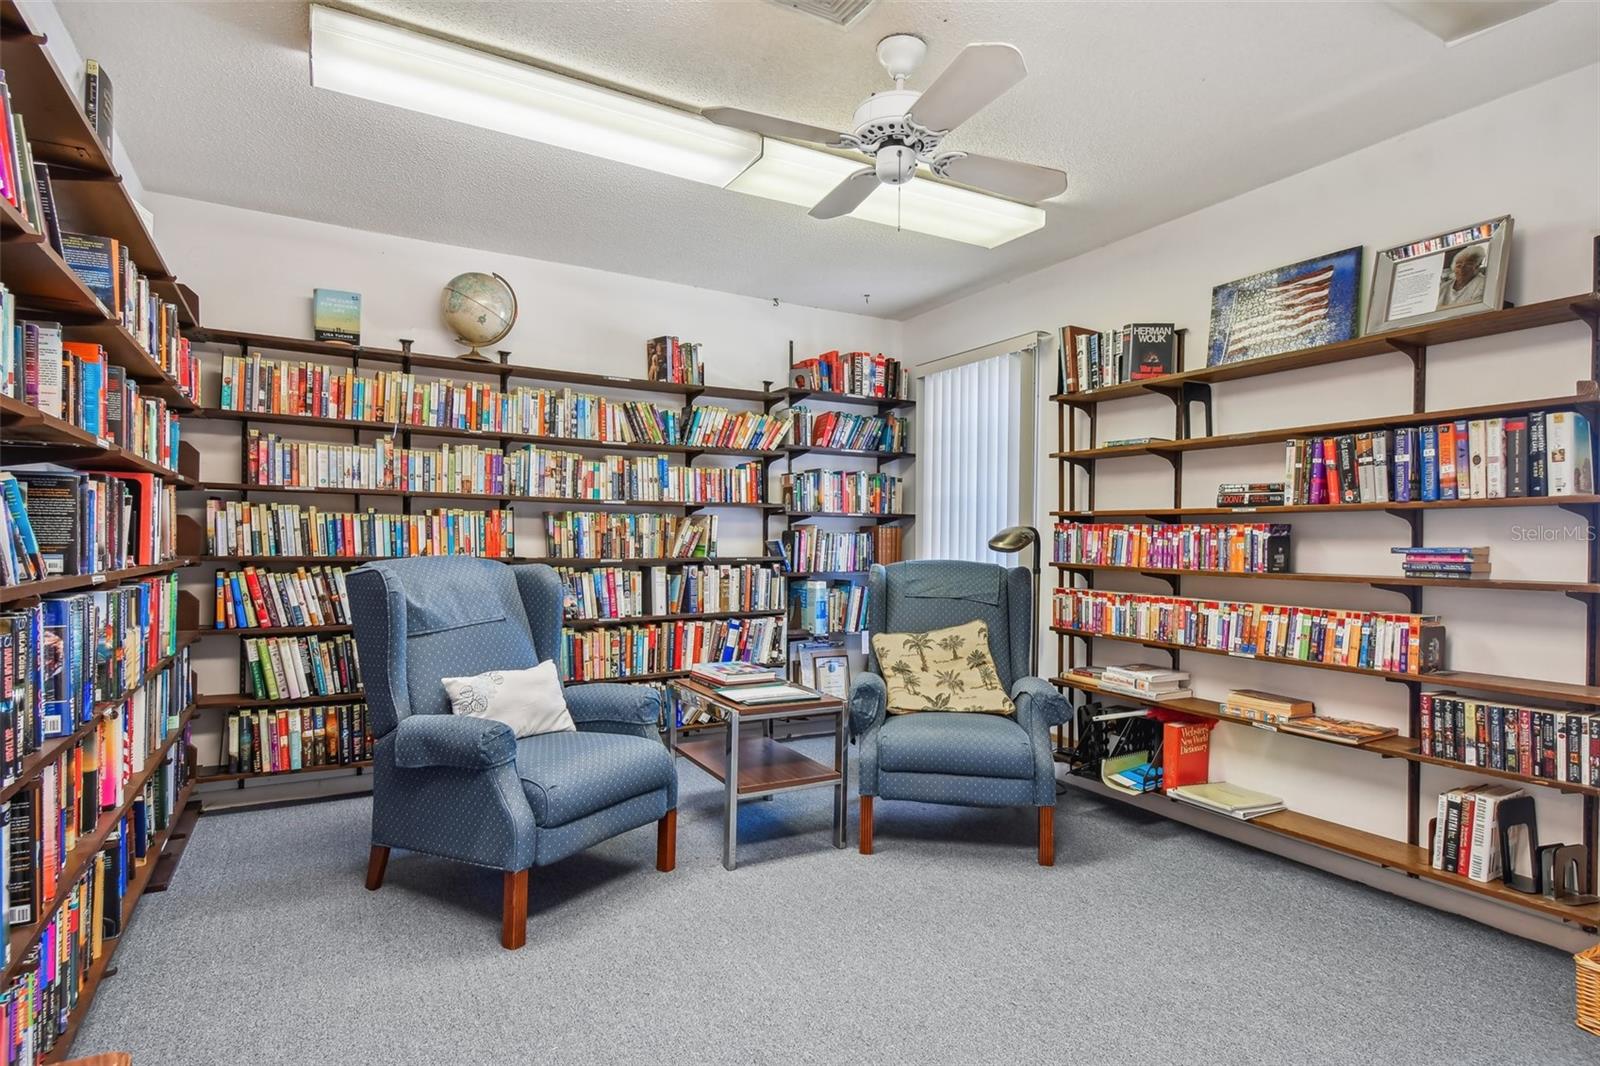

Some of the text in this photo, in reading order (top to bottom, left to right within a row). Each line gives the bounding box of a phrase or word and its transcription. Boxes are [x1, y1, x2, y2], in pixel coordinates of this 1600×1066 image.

[1133, 326, 1172, 335] HERMAN
[1138, 334, 1167, 343] WOUK
[1180, 744, 1208, 755] Dictionary
